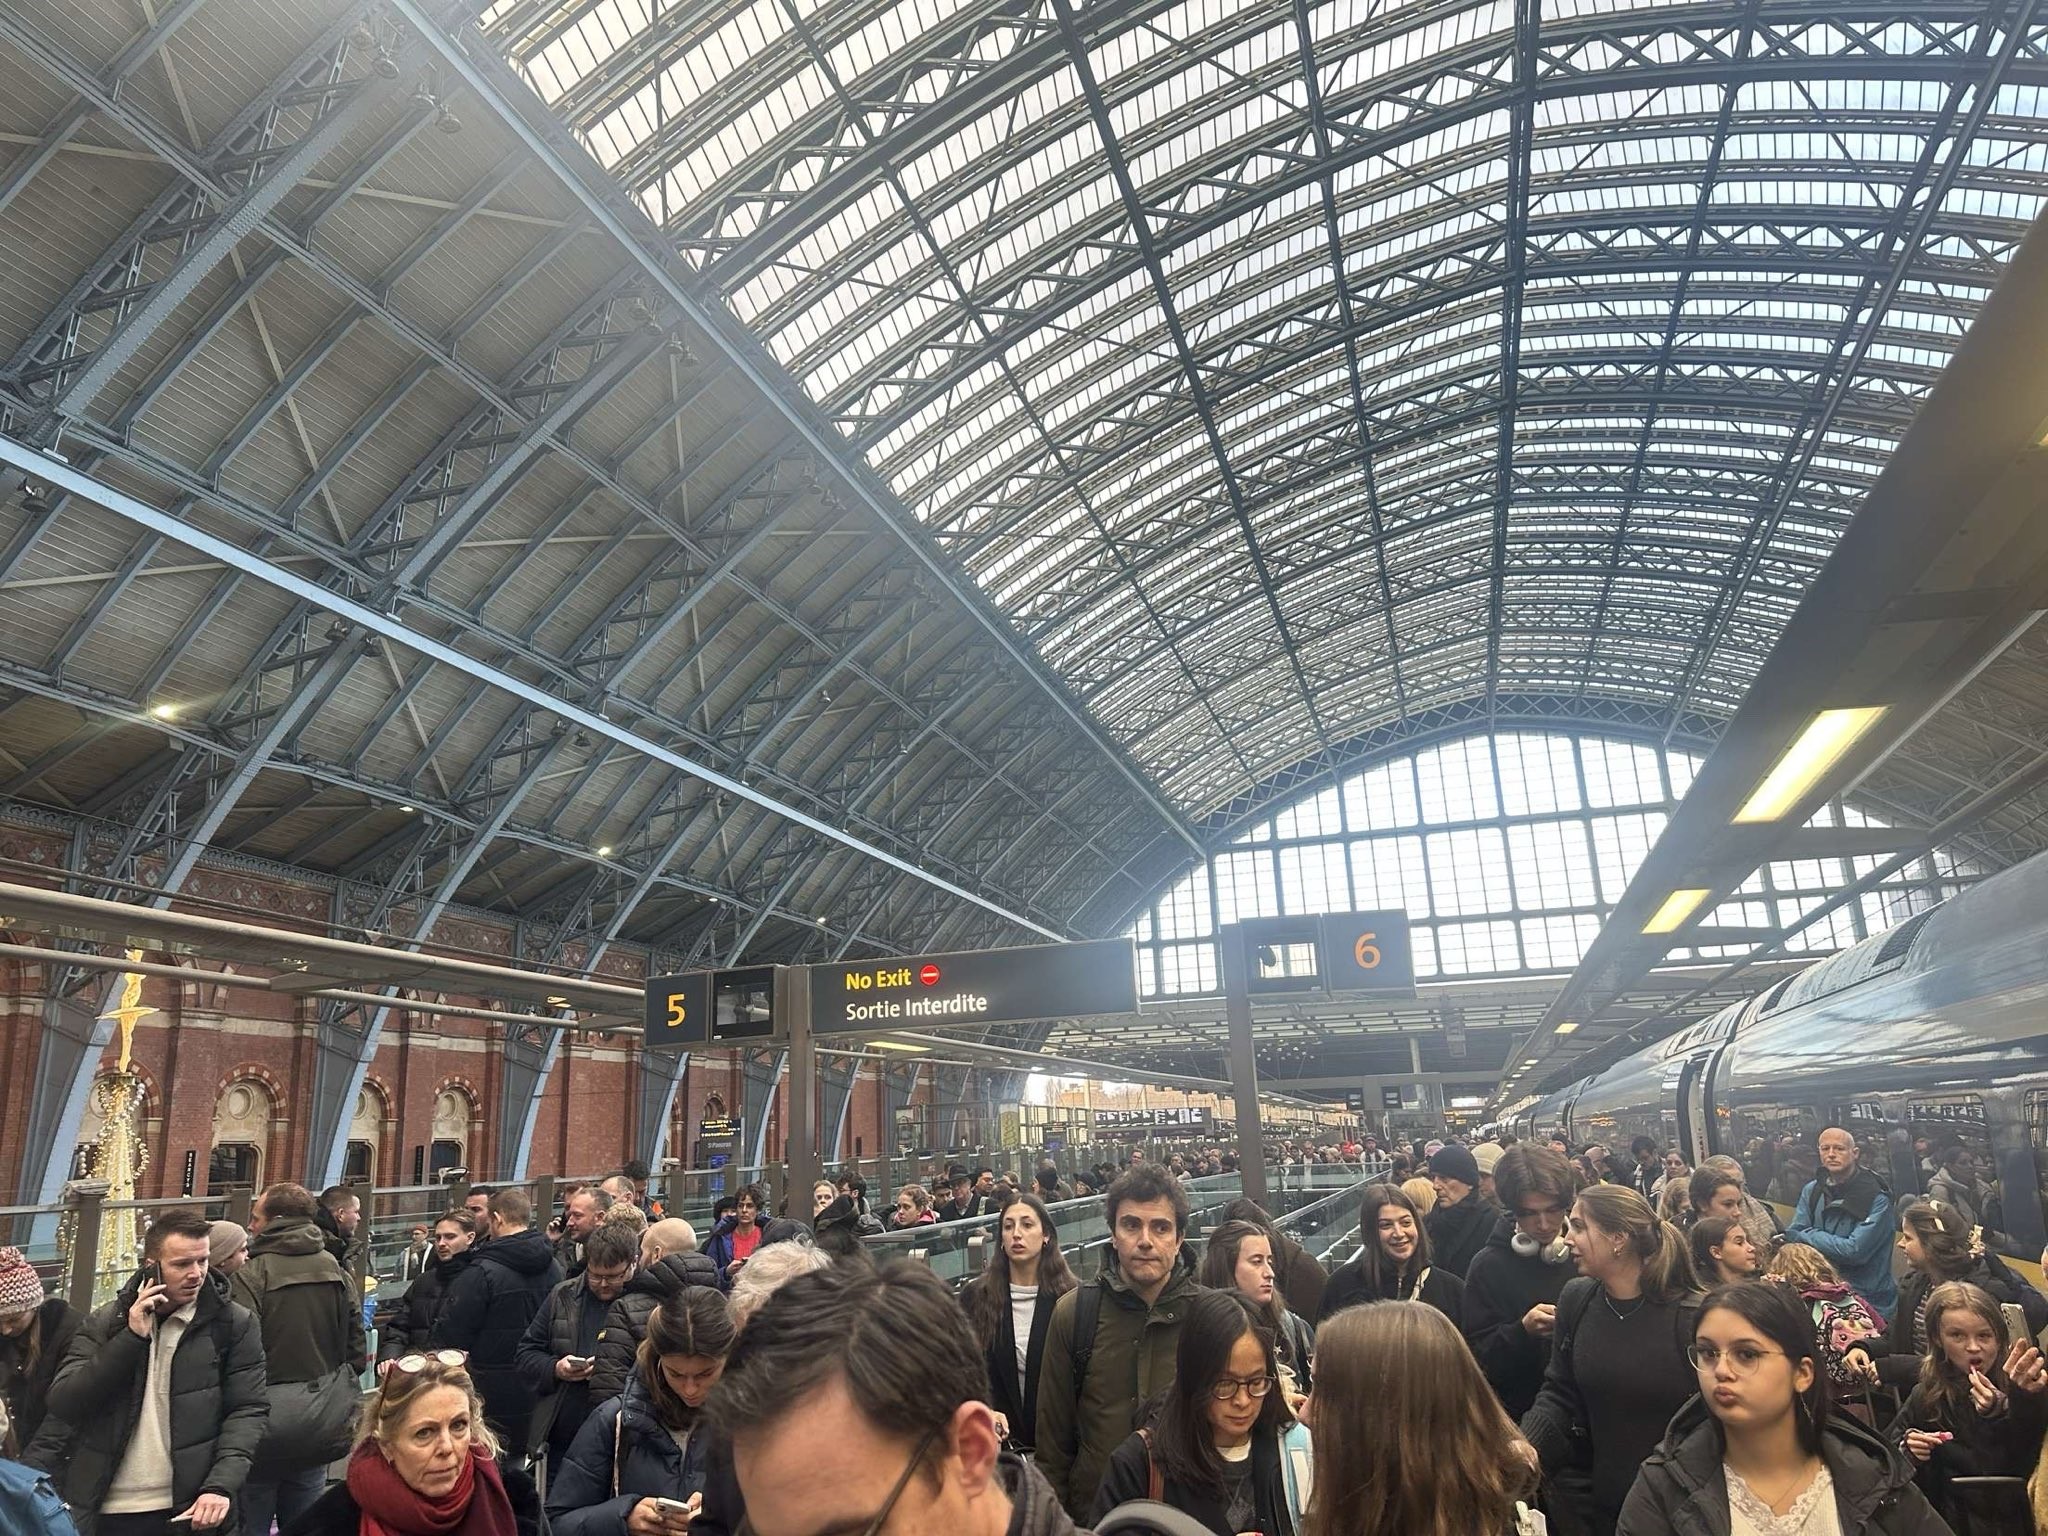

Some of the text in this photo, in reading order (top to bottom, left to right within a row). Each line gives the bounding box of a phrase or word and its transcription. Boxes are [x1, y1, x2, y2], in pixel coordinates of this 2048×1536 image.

[1355, 932, 1381, 969] 6
[846, 968, 912, 990] No Exit
[667, 993, 686, 1027] 5
[846, 993, 988, 1021] Sortie Interdite
